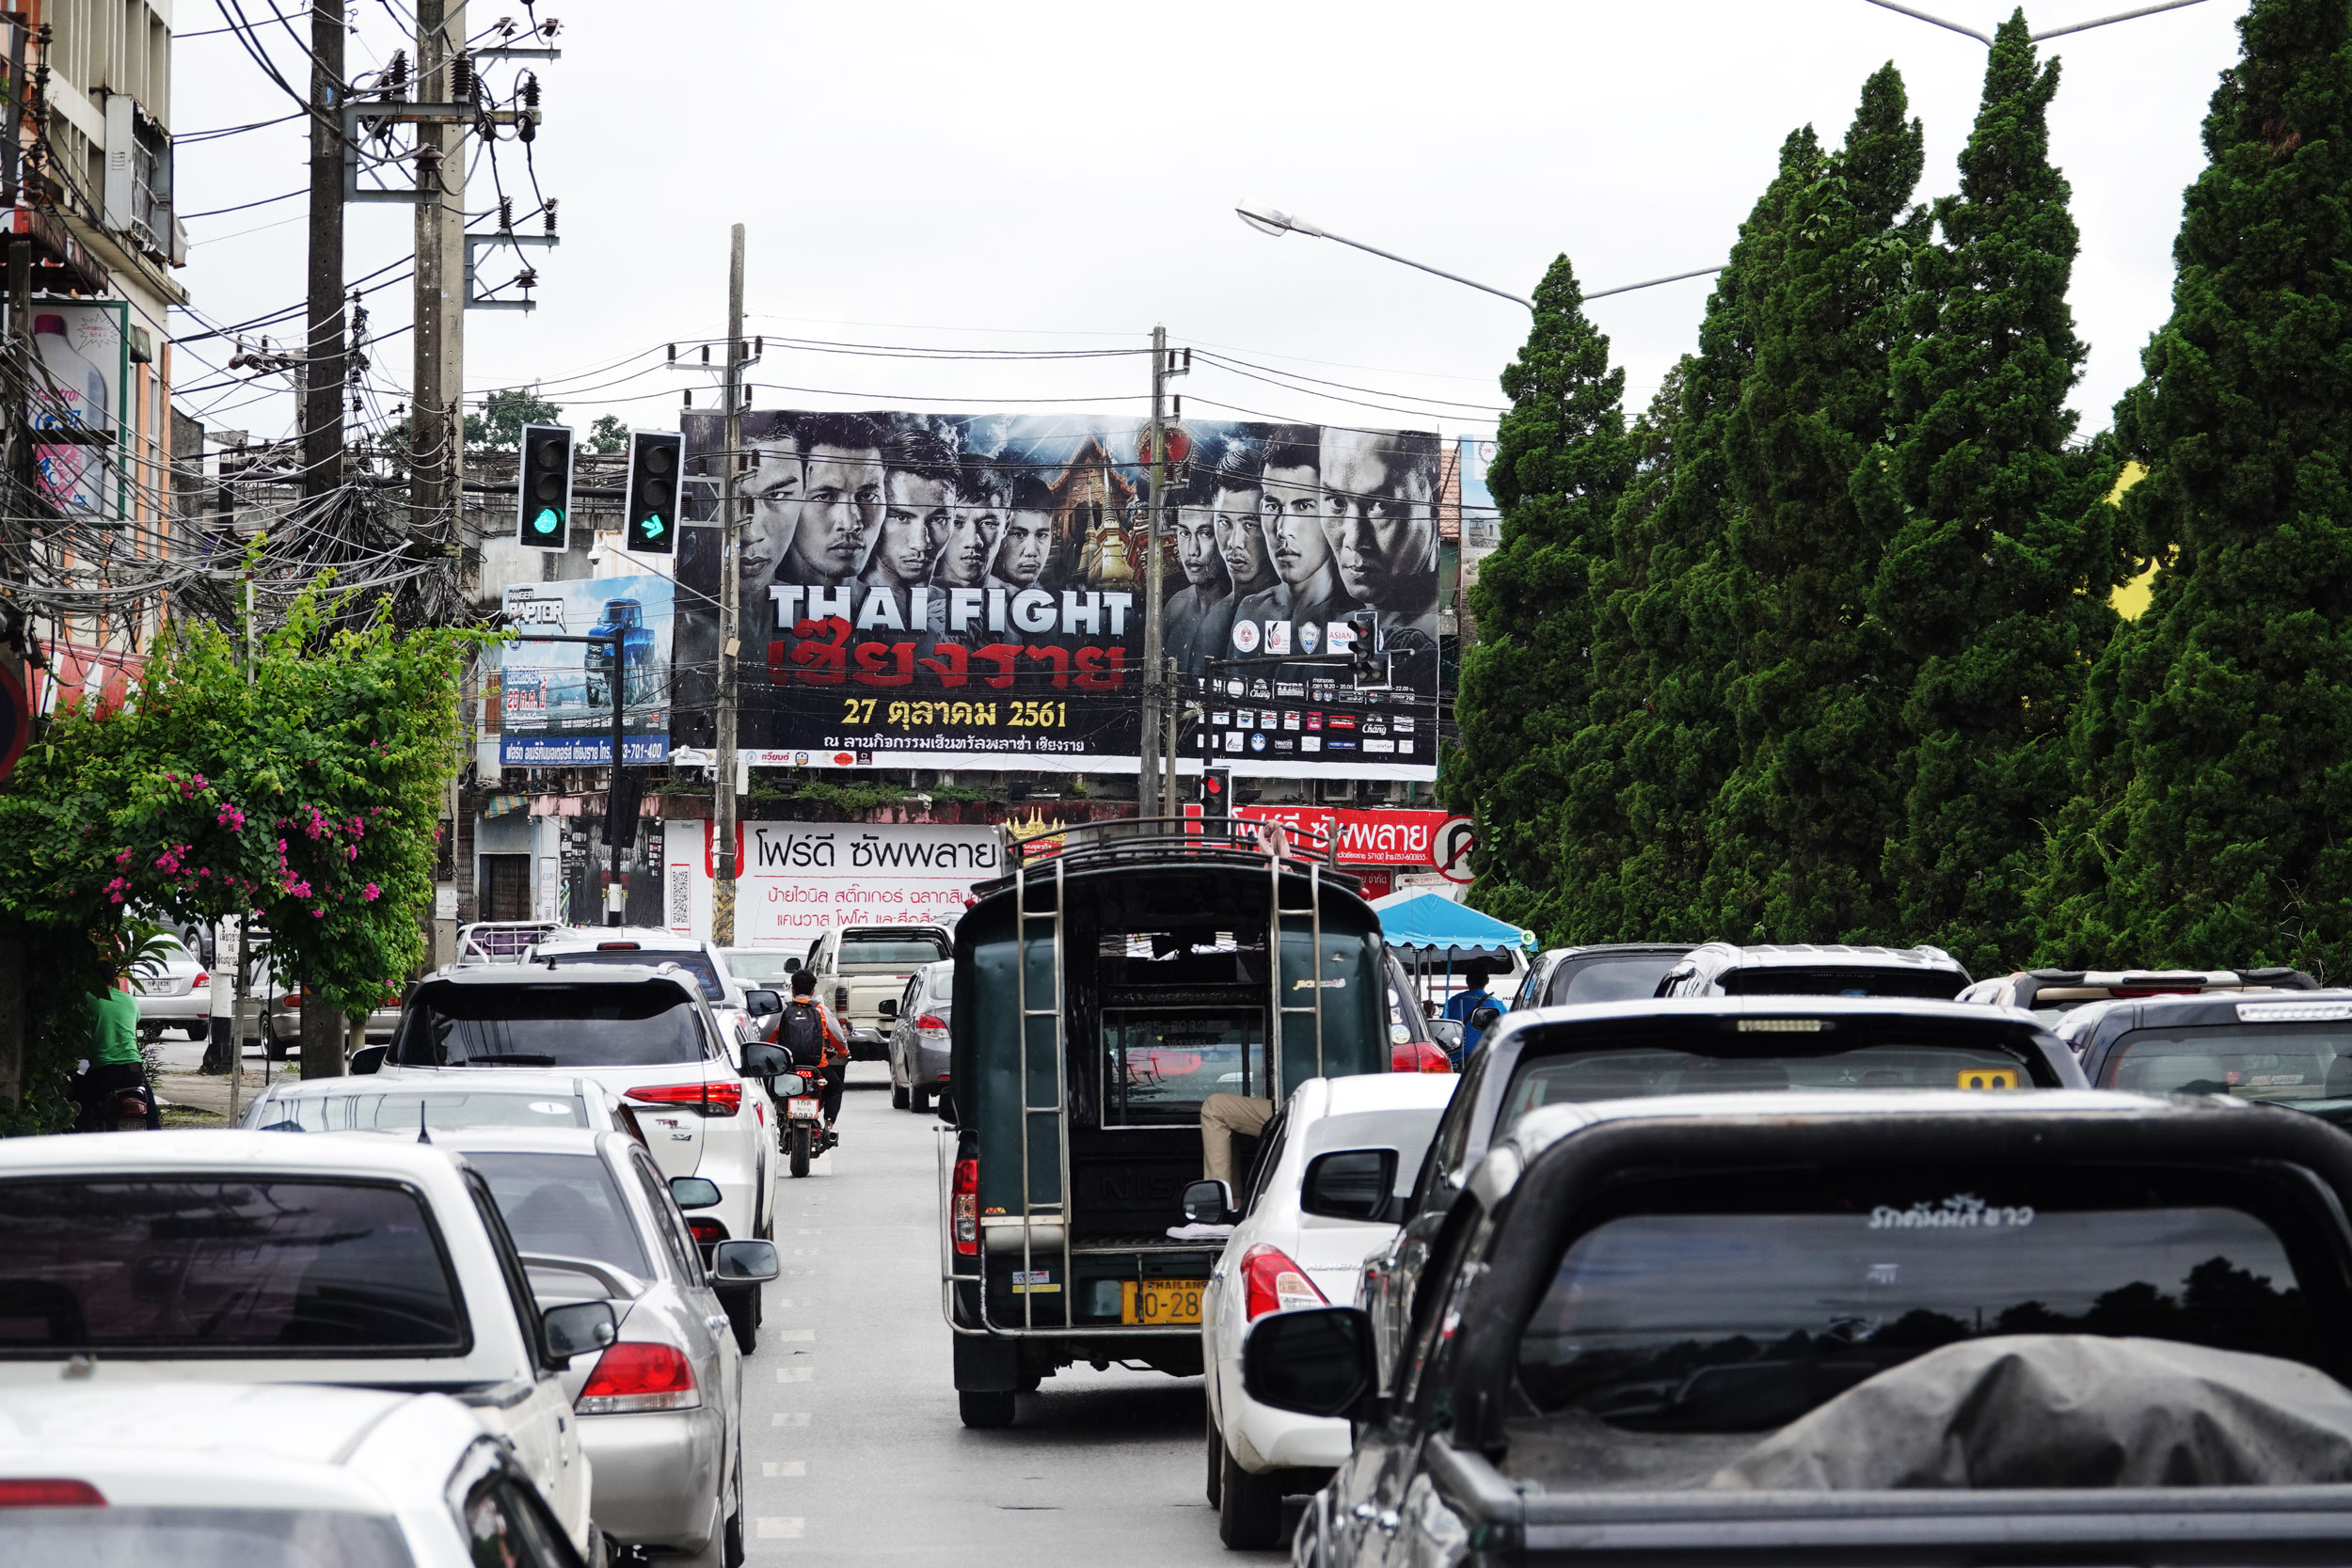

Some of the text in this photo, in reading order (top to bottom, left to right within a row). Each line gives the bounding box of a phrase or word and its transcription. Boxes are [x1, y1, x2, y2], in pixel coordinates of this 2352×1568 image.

[768, 584, 1133, 637] THAI FIGHT
[840, 699, 1067, 731] 27 ตุลาคม 2561
[1362, 723, 1387, 736] Chang
[506, 740, 523, 760] ฟอร์ด
[622, 743, 662, 760] 3-701-400
[824, 736, 839, 747] ณ
[1231, 807, 1300, 846] โฟ์ดี
[755, 829, 996, 868] โฟร์ดี ซัพพลาย
[769, 885, 829, 903] ป้ายไวนิล
[834, 883, 903, 903] สติ๊กเกอร์
[777, 914, 830, 927] แคนวาส
[1135, 1292, 1203, 1318] 10-28
